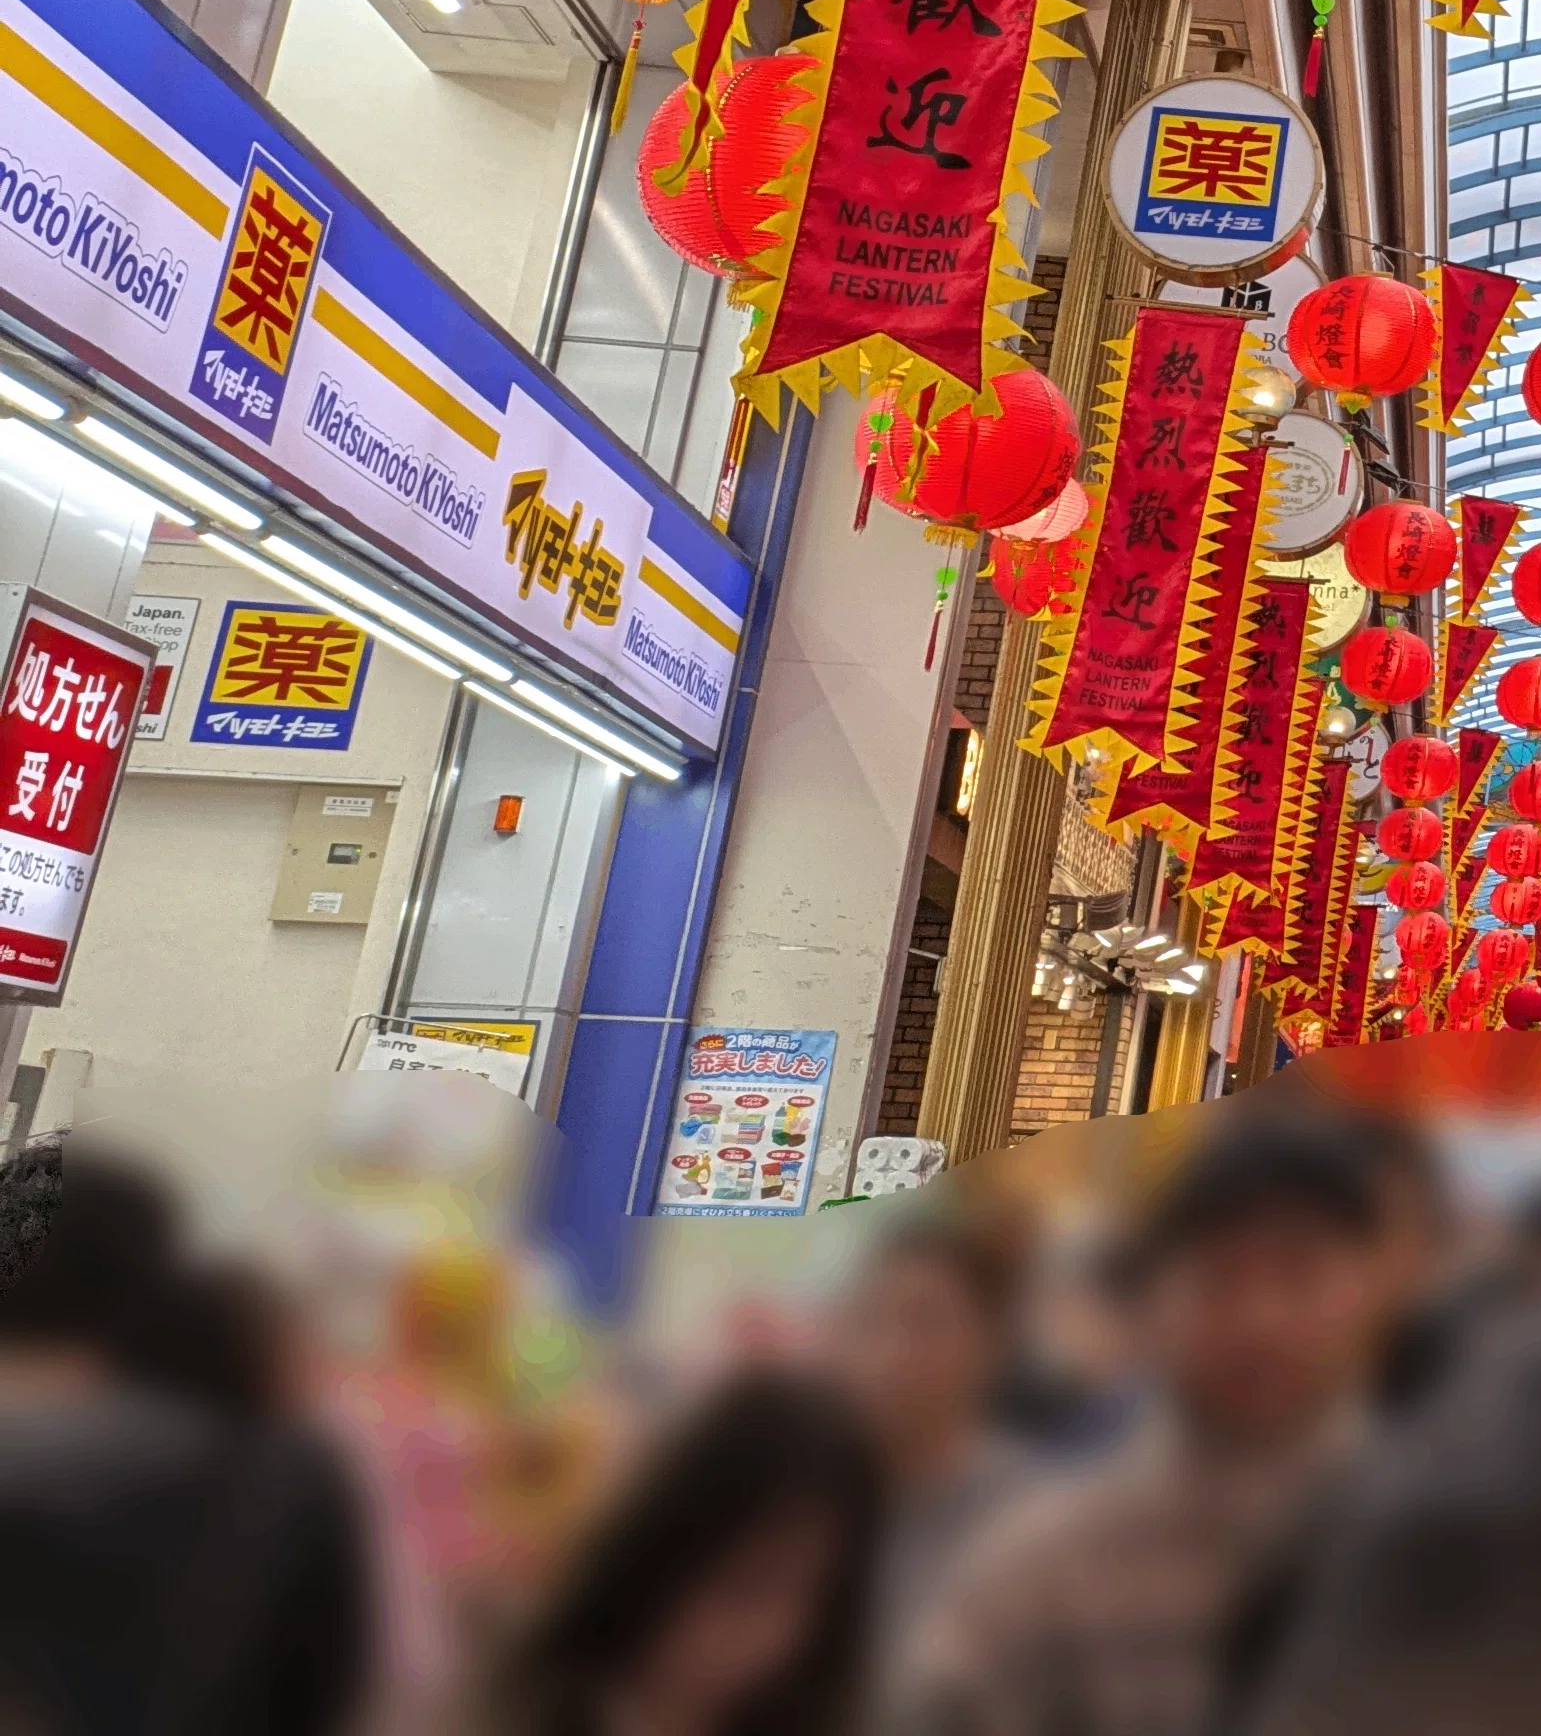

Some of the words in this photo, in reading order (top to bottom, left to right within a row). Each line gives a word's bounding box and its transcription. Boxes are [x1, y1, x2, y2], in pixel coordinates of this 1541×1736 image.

[1157, 120, 1274, 202] 薬
[837, 199, 973, 240] NAGASAKI
[1147, 204, 1266, 234] マツモトキヨシ
[834, 236, 960, 274] LANTERN
[220, 185, 316, 365] 薬
[828, 270, 950, 308] FESTIVAL
[203, 349, 274, 421] マツモトキヨシ
[306, 381, 419, 498] Matsumoto
[1102, 340, 1206, 632] 熱烈歡迎
[131, 604, 186, 621] Japan.
[220, 614, 360, 705] 薬
[1086, 648, 1161, 673] NAGASAKI
[8, 642, 125, 751] 処方せん
[1078, 688, 1148, 713] FESTIVAL
[1084, 670, 1152, 693] LANTERN
[205, 710, 342, 742] マツモトキヨシ
[8, 751, 85, 833] 受付
[691, 1051, 825, 1077] 充実しました!
